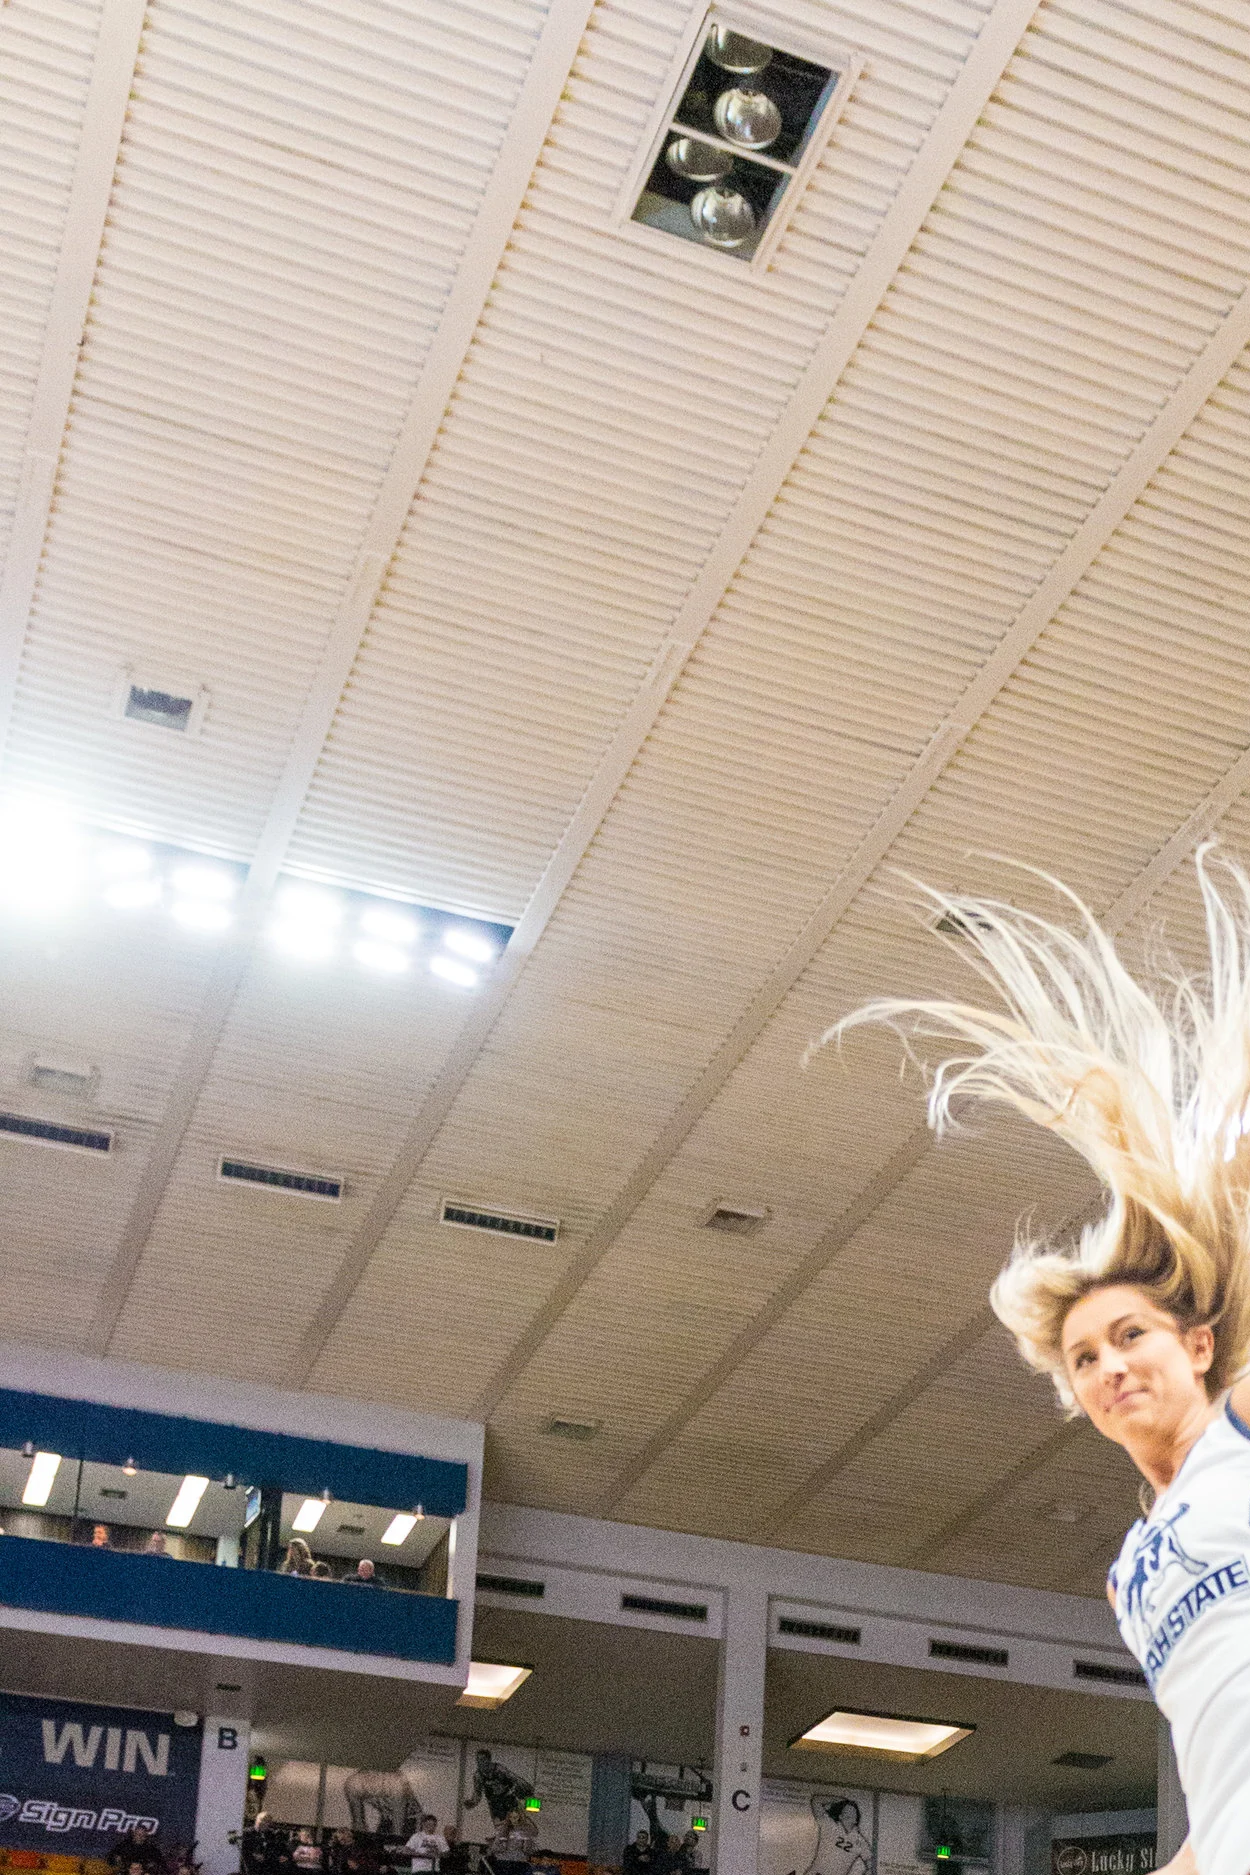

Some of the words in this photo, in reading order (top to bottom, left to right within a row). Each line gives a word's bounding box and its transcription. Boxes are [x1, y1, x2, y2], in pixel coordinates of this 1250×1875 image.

[1167, 1559, 1249, 1638] STATE
[41, 1719, 171, 1776] WIN
[217, 1726, 238, 1750] B
[732, 1789, 751, 1812] C
[18, 1800, 98, 1833] Sign
[97, 1807, 160, 1835] Pro
[835, 1836, 854, 1852] 22
[1091, 1849, 1136, 1873] Lucky
